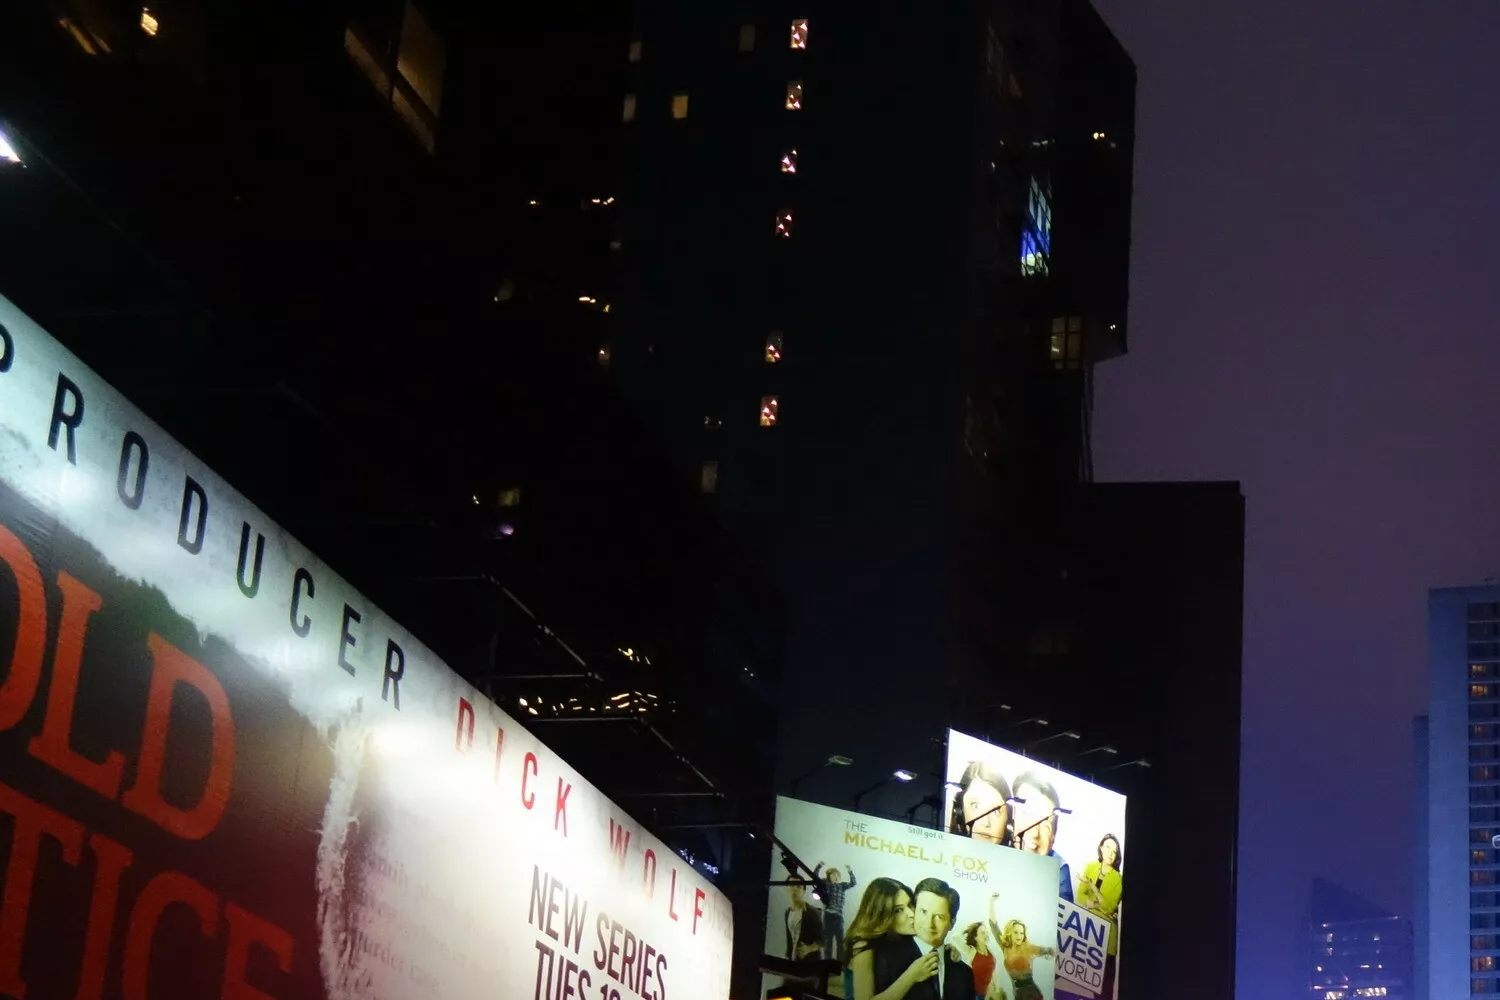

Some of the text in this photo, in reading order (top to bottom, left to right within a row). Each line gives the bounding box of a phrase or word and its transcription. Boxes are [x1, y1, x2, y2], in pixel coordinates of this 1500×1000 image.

[456, 696, 571, 838] DICK
[609, 817, 706, 936] WOLF
[845, 819, 868, 833] THE
[844, 831, 988, 873] MICHAEL J. FOX
[953, 868, 989, 883] SHOW
[529, 865, 588, 955] NEW
